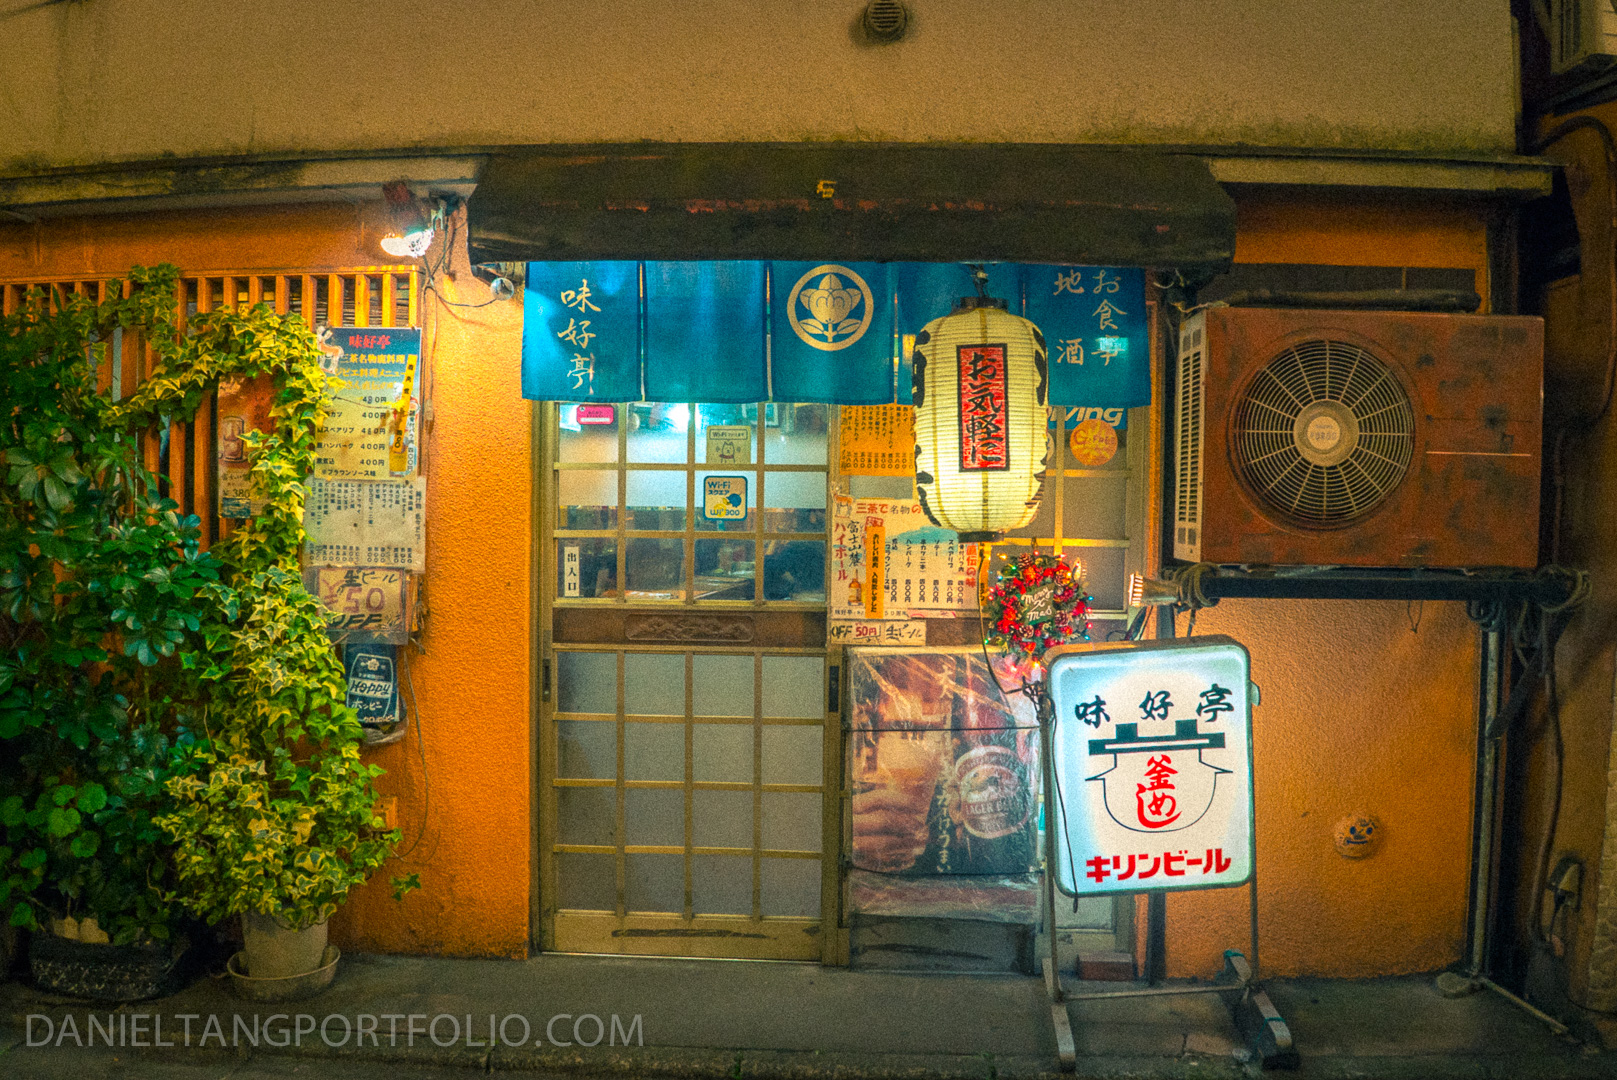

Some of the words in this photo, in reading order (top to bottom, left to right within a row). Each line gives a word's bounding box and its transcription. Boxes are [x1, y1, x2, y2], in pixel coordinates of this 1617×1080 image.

[348, 334, 391, 349] 味好亭
[557, 278, 601, 390] 味好亭
[965, 351, 1003, 464] お気軽に
[360, 459, 385, 467] 400円
[707, 481, 731, 489] Wi-Fi
[834, 522, 848, 581] ハイボール
[344, 567, 398, 587] 生ビール
[567, 552, 577, 591] 出入口
[855, 626, 877, 638] 50円
[350, 680, 391, 695] Hoppy
[352, 698, 383, 711] ホッピー
[1074, 683, 1234, 729] 味好亭
[1136, 754, 1182, 829] 釜めし
[1086, 848, 1231, 883] キリンビール
